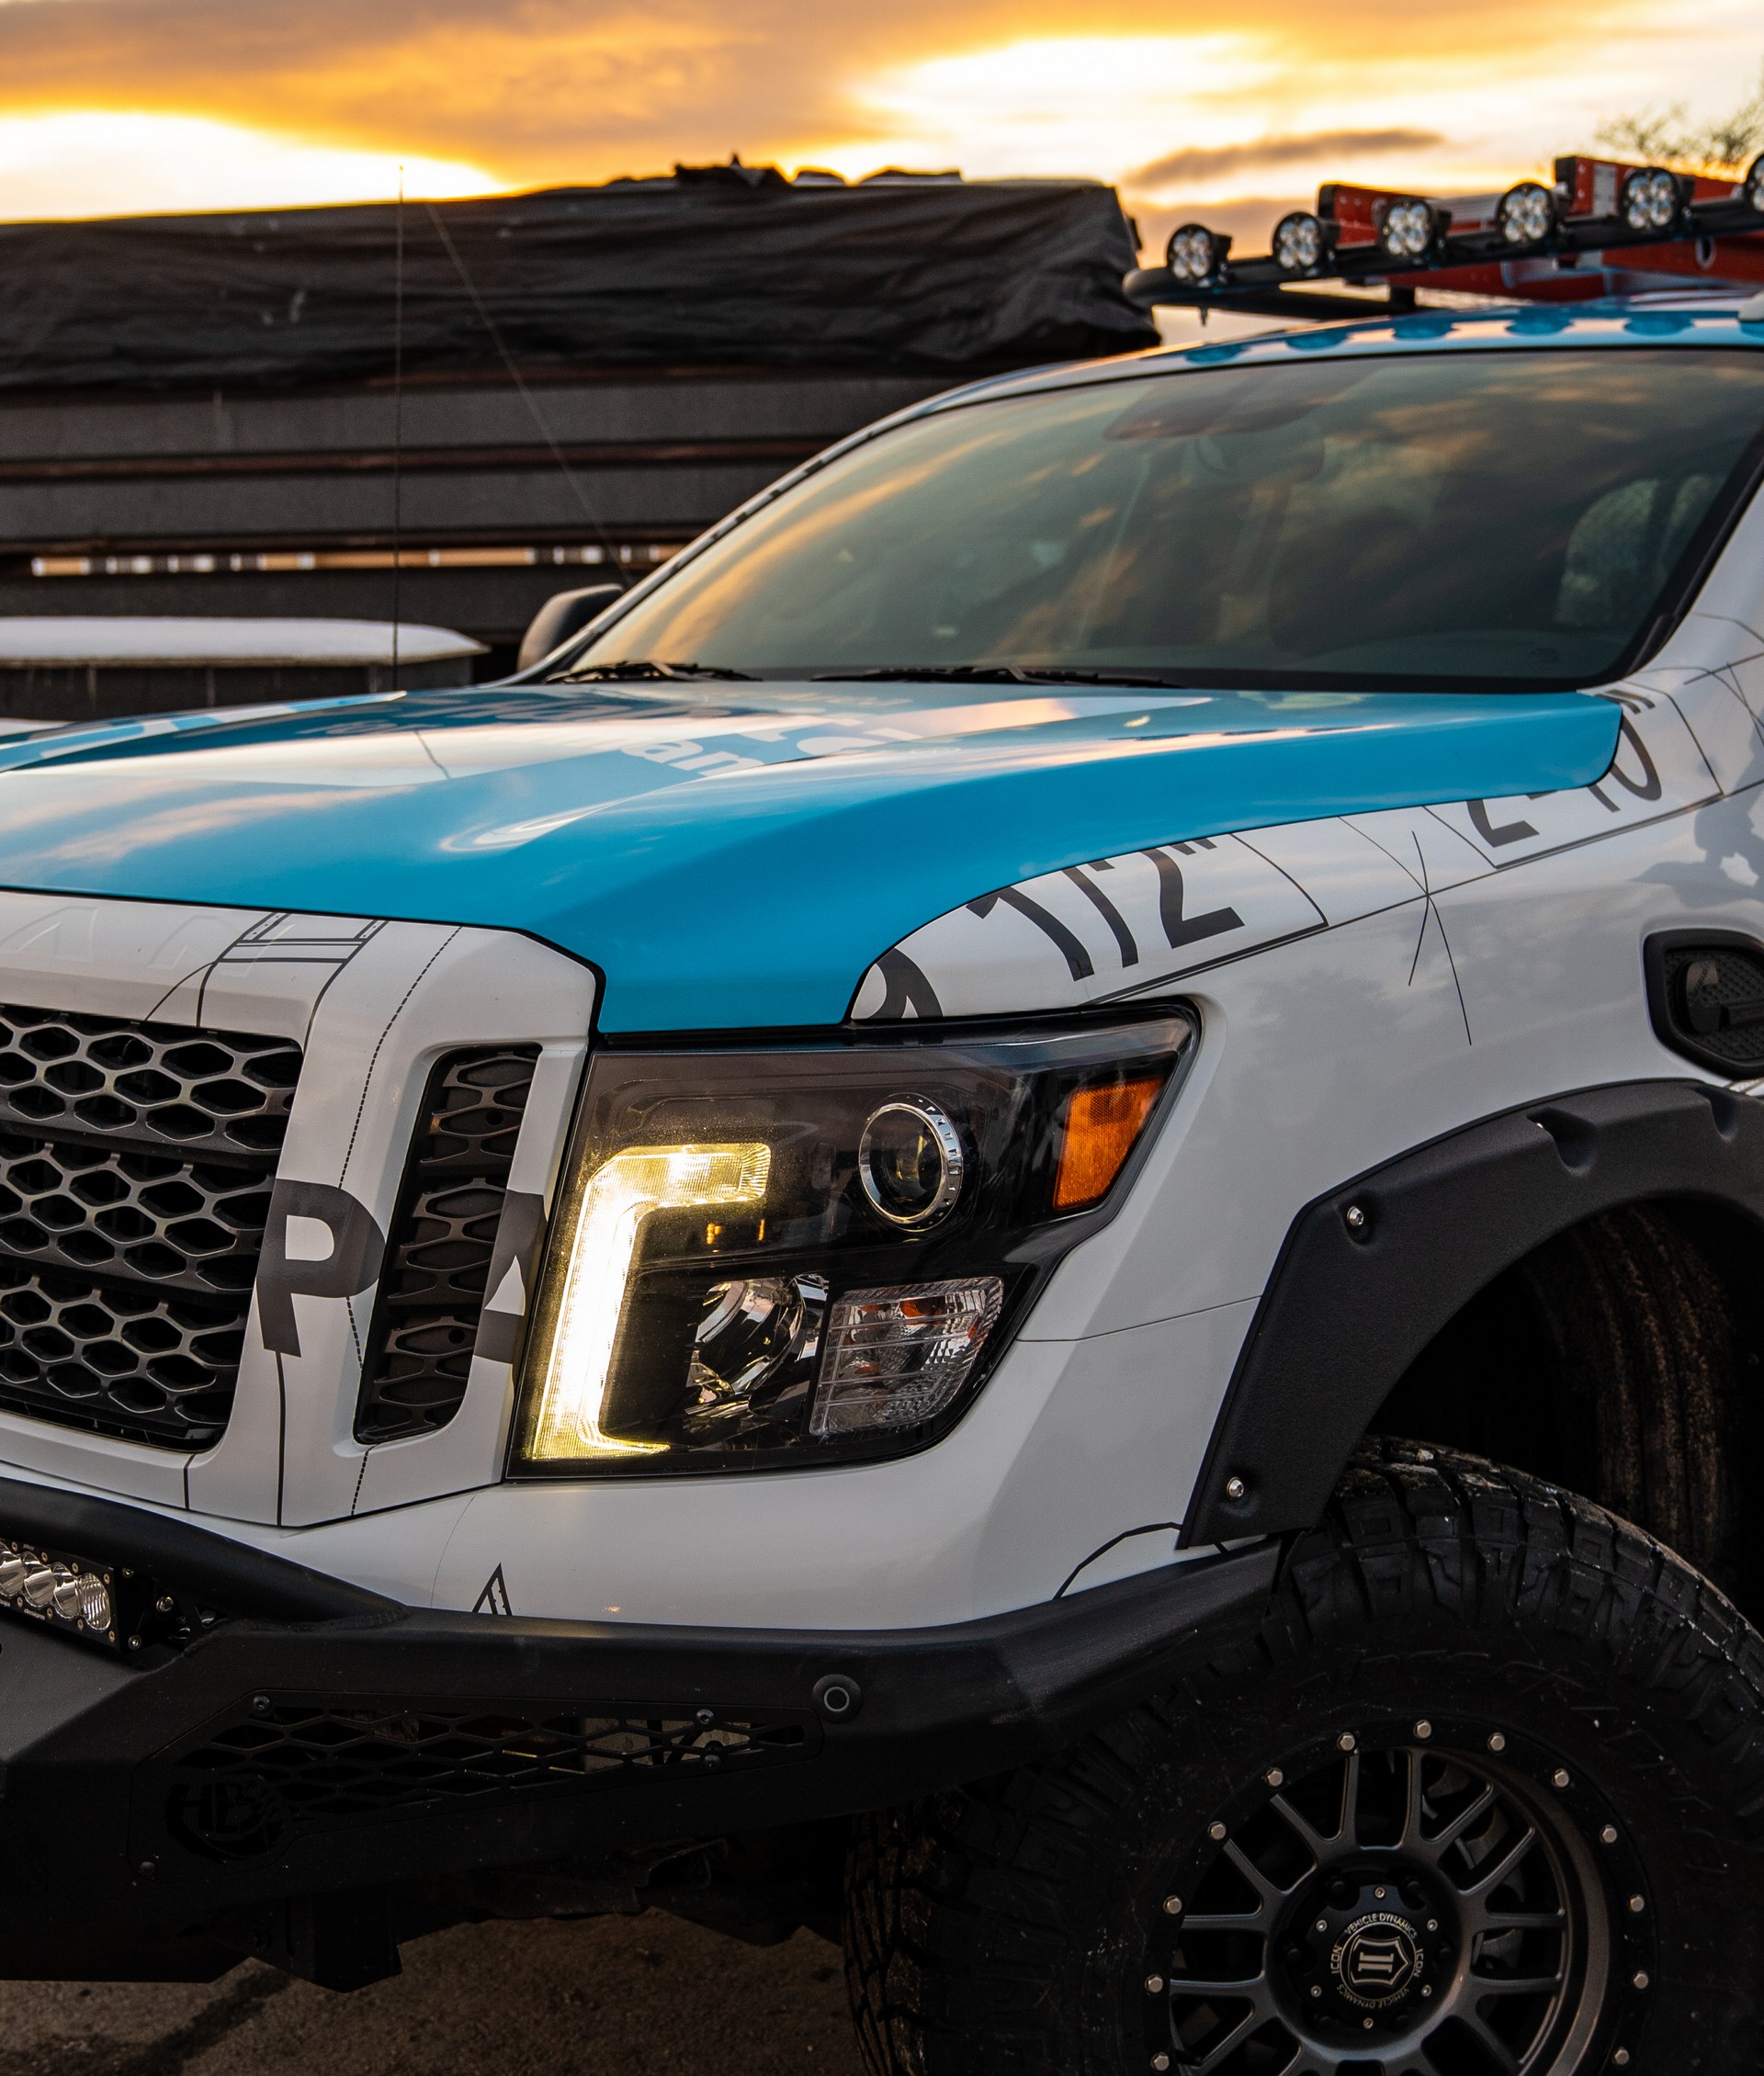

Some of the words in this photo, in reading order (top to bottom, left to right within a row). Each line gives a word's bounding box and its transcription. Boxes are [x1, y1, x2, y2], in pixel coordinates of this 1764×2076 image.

[1344, 1913, 1378, 1935] VEHICLE
[1379, 1912, 1418, 1940] DYNAMICS
[1330, 1945, 1342, 1974] ICON
[1413, 1947, 1424, 1978] ICON
[1337, 1984, 1375, 2009] DYNAMICS
[1378, 1988, 1410, 2009] VEHICLE
